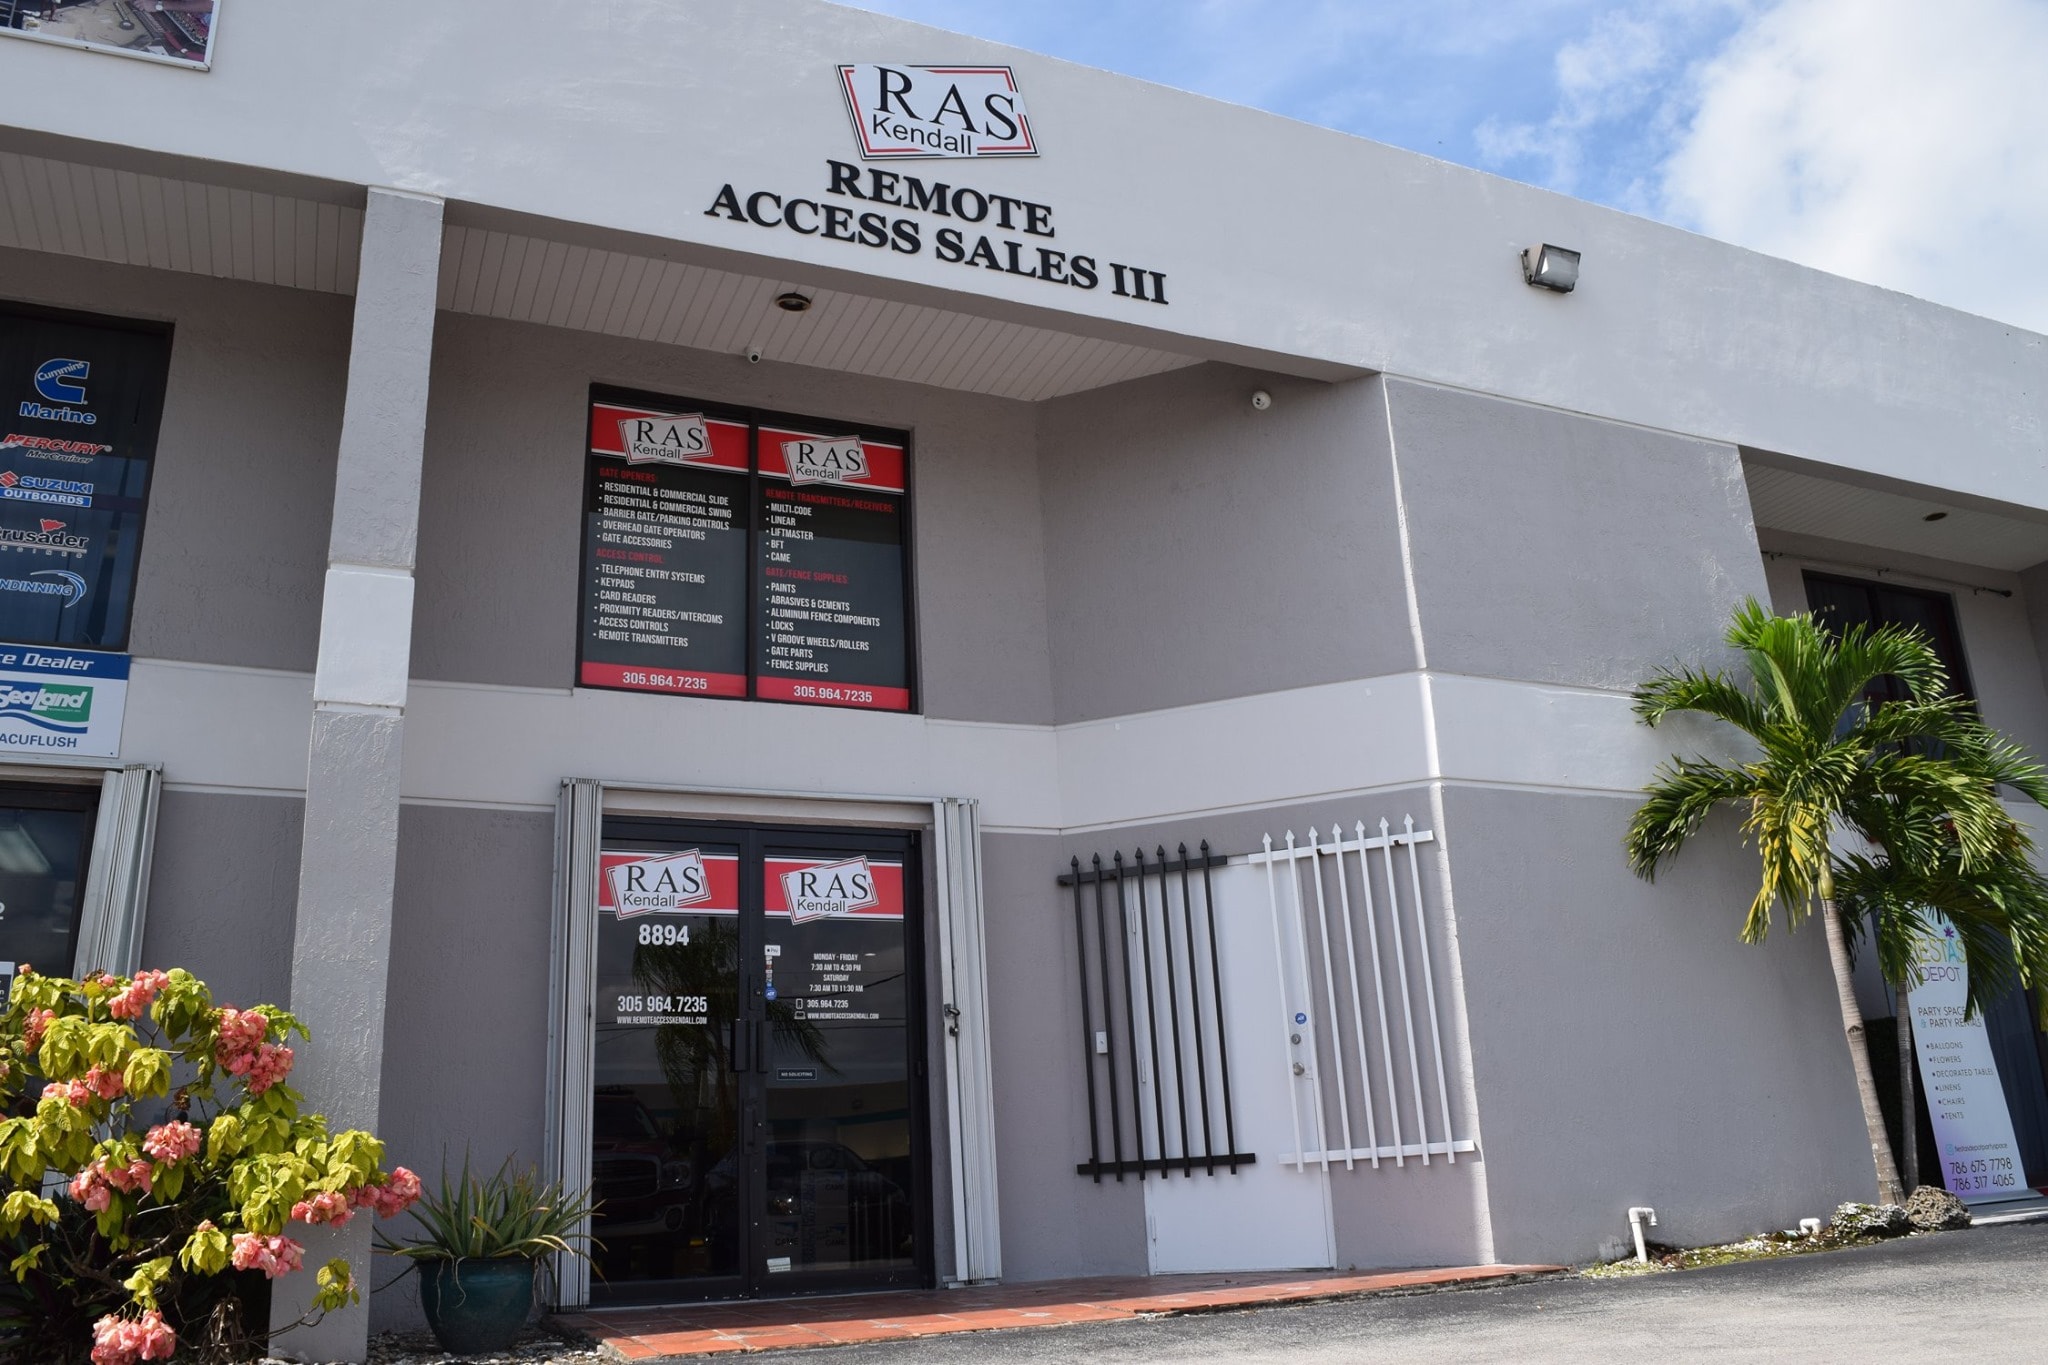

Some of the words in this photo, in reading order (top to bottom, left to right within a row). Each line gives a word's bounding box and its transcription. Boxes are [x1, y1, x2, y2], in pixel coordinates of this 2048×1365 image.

[874, 66, 1018, 140] RAS
[872, 114, 972, 155] Kendall
[826, 159, 1055, 238] REMOTE
[703, 183, 922, 254] ACCESS
[936, 228, 1098, 290] SALES
[1110, 262, 1170, 305] III
[37, 362, 85, 381] Cummins
[20, 402, 97, 425] Marine
[636, 420, 704, 450] RAS
[3, 433, 103, 455] MERCURY
[633, 443, 681, 459] Kendall
[797, 443, 861, 472] RAS
[600, 468, 618, 479] GATE
[796, 465, 840, 480] Kendall
[20, 476, 94, 494] SUZUKI
[4, 489, 84, 505] OUTBOARDS
[605, 482, 651, 497] RESIDENTIAL
[660, 489, 706, 503] COMMERCIAL
[709, 495, 729, 506] SLIDE
[604, 495, 651, 509] RESIDENTIAL
[660, 501, 706, 516] COMMERCIAL
[709, 508, 732, 518] SWING
[604, 507, 639, 520] BARRIER
[637, 512, 691, 526] GATE/PARKING
[692, 519, 729, 530] CONTROLS
[771, 515, 796, 526] LINEAR
[0, 526, 89, 548] rusader
[603, 520, 642, 533] OVERHEAD
[644, 524, 662, 535] GATE
[663, 527, 706, 540] OPERATORS
[771, 528, 814, 540] LIFTMASTER
[602, 533, 621, 544] GATE
[623, 536, 672, 549] ACCESSORIES
[771, 540, 784, 549] BFT
[596, 548, 626, 560] ACCESS
[771, 552, 791, 562] CAME
[601, 564, 644, 578] TELEPHONE
[646, 569, 669, 580] ENTRY
[671, 572, 705, 584] SYSTEMS
[766, 567, 812, 580] GATE/FENCE
[601, 577, 635, 589] KEYPADS
[771, 582, 796, 594] PAINTS
[600, 590, 621, 601] CARD
[622, 592, 656, 604] READERS
[771, 595, 810, 607] ABRASIVES
[817, 600, 850, 611] CEMENTS
[600, 603, 641, 616] PROXIMITY
[642, 607, 723, 624] READERS/INTERCOMS
[771, 608, 809, 620] ALUMINUM
[811, 611, 832, 622] FENCE
[834, 614, 880, 627] COMPONENTS
[599, 617, 628, 628] ACCESS
[630, 620, 669, 632] CONTROLS
[771, 621, 794, 631] LOCKS
[599, 630, 630, 642] REMOTE
[632, 633, 688, 647] TRANSMITTERS
[771, 634, 776, 642] V
[777, 634, 805, 646] GROOVE
[807, 636, 870, 651] WHEELS/ROLLERS
[771, 646, 789, 656] GATE
[790, 648, 813, 658] PARTS
[22, 653, 95, 671] Dealer
[771, 659, 794, 670] FENCE
[795, 661, 829, 673] SUPPLIES
[623, 672, 708, 690] 305.964.7235
[794, 685, 872, 702] 305.964.7235
[624, 865, 700, 894] RAS
[798, 872, 868, 900] RAS
[623, 893, 675, 907] Kendall
[797, 899, 846, 912] Kendall
[638, 924, 689, 946] 8894
[813, 953, 835, 961] MONDAY
[840, 953, 858, 961] FRIDAY
[823, 974, 850, 982] SATURDAY
[1920, 967, 1960, 982] DEPOT
[810, 984, 822, 992] 7:30
[822, 984, 831, 992] AM
[831, 984, 838, 992] TO
[840, 984, 855, 992] 11:30
[618, 996, 642, 1012] 305
[647, 996, 708, 1012] 964.7235
[807, 1000, 849, 1008] 305.964.7235
[1918, 1006, 1941, 1016] PARTY
[617, 1016, 708, 1025] WWW.REMOTEACCESSKENDALL.COM
[1930, 1018, 1952, 1028] PARTY
[1930, 1042, 1963, 1050] BALLOONS
[1933, 1056, 1962, 1064] FLOWERS
[1936, 1069, 1973, 1078] DECORATED
[1939, 1084, 1962, 1092] LINENS
[1942, 1098, 1965, 1106] CHAIRS
[1945, 1112, 1964, 1120] TENTS
[1949, 1162, 1968, 1174] 786
[1971, 1160, 1986, 1172] 675
[1990, 1157, 2012, 1170] 7798
[1953, 1178, 1971, 1191] 786
[1974, 1176, 1988, 1188] 317
[1992, 1174, 2015, 1186] 4065
